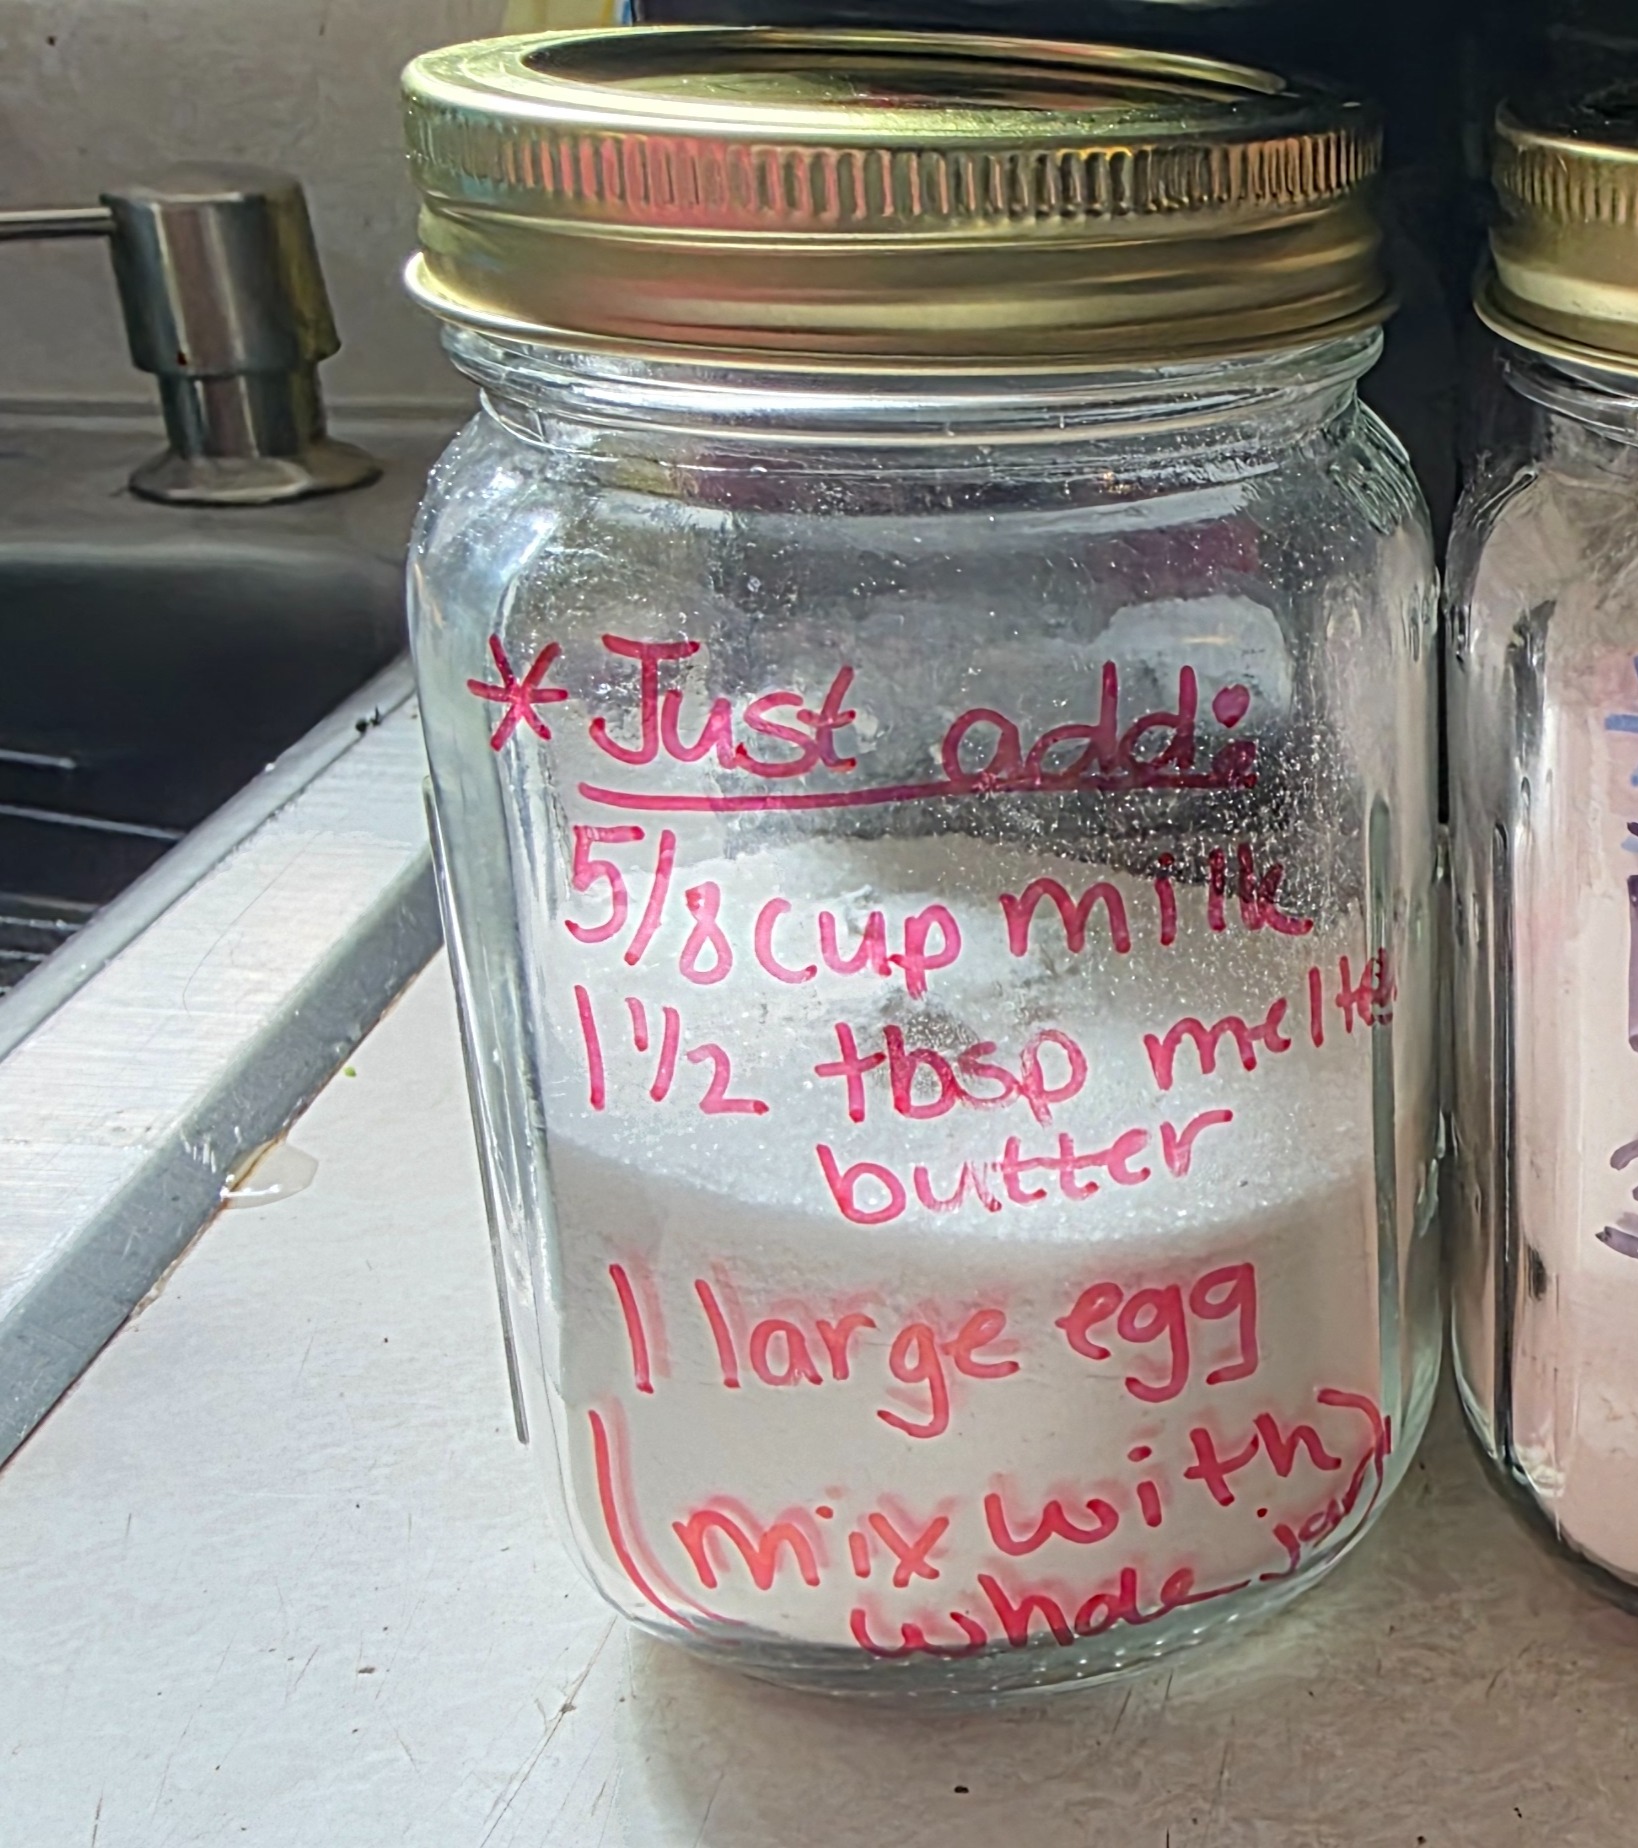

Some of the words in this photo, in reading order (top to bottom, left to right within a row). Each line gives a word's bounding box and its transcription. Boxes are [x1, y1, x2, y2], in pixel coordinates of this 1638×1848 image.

[999, 843, 1314, 957] milk
[814, 1022, 1089, 1129] tbsp
[816, 1109, 1233, 1225] butter
[607, 1262, 655, 1394] 1
[695, 1278, 1020, 1440] large
[1055, 1261, 1258, 1404] egg
